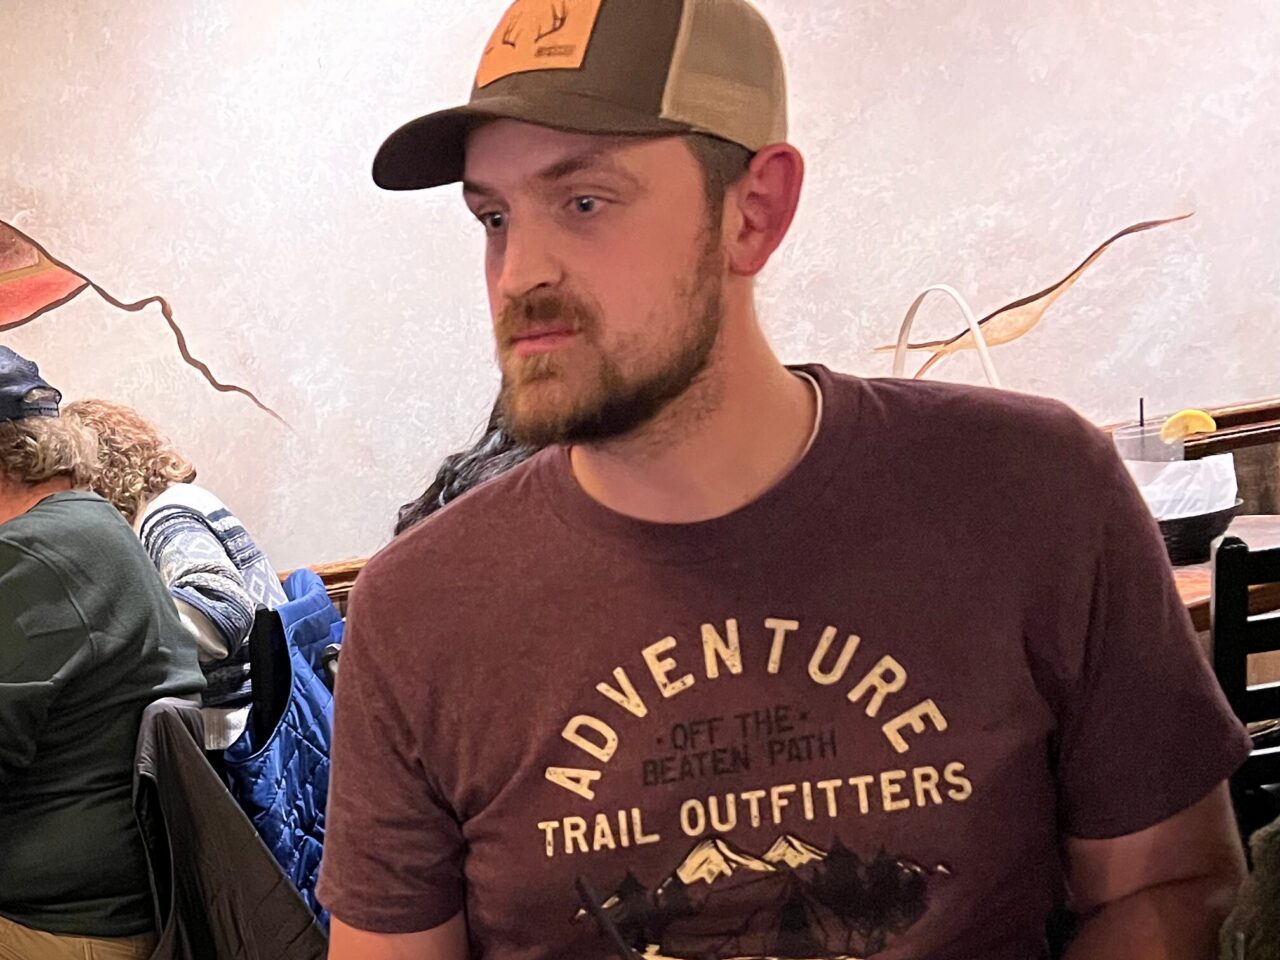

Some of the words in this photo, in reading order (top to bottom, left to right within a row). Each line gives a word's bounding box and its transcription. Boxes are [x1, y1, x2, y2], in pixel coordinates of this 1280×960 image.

[545, 617, 948, 800] ADVENTURE
[672, 717, 723, 750] OFF
[735, 706, 793, 738] THE
[642, 744, 751, 786] BEATEN
[767, 727, 837, 766] PATH
[537, 807, 660, 857] TRAIL
[680, 761, 972, 837] OUTFITTERS
